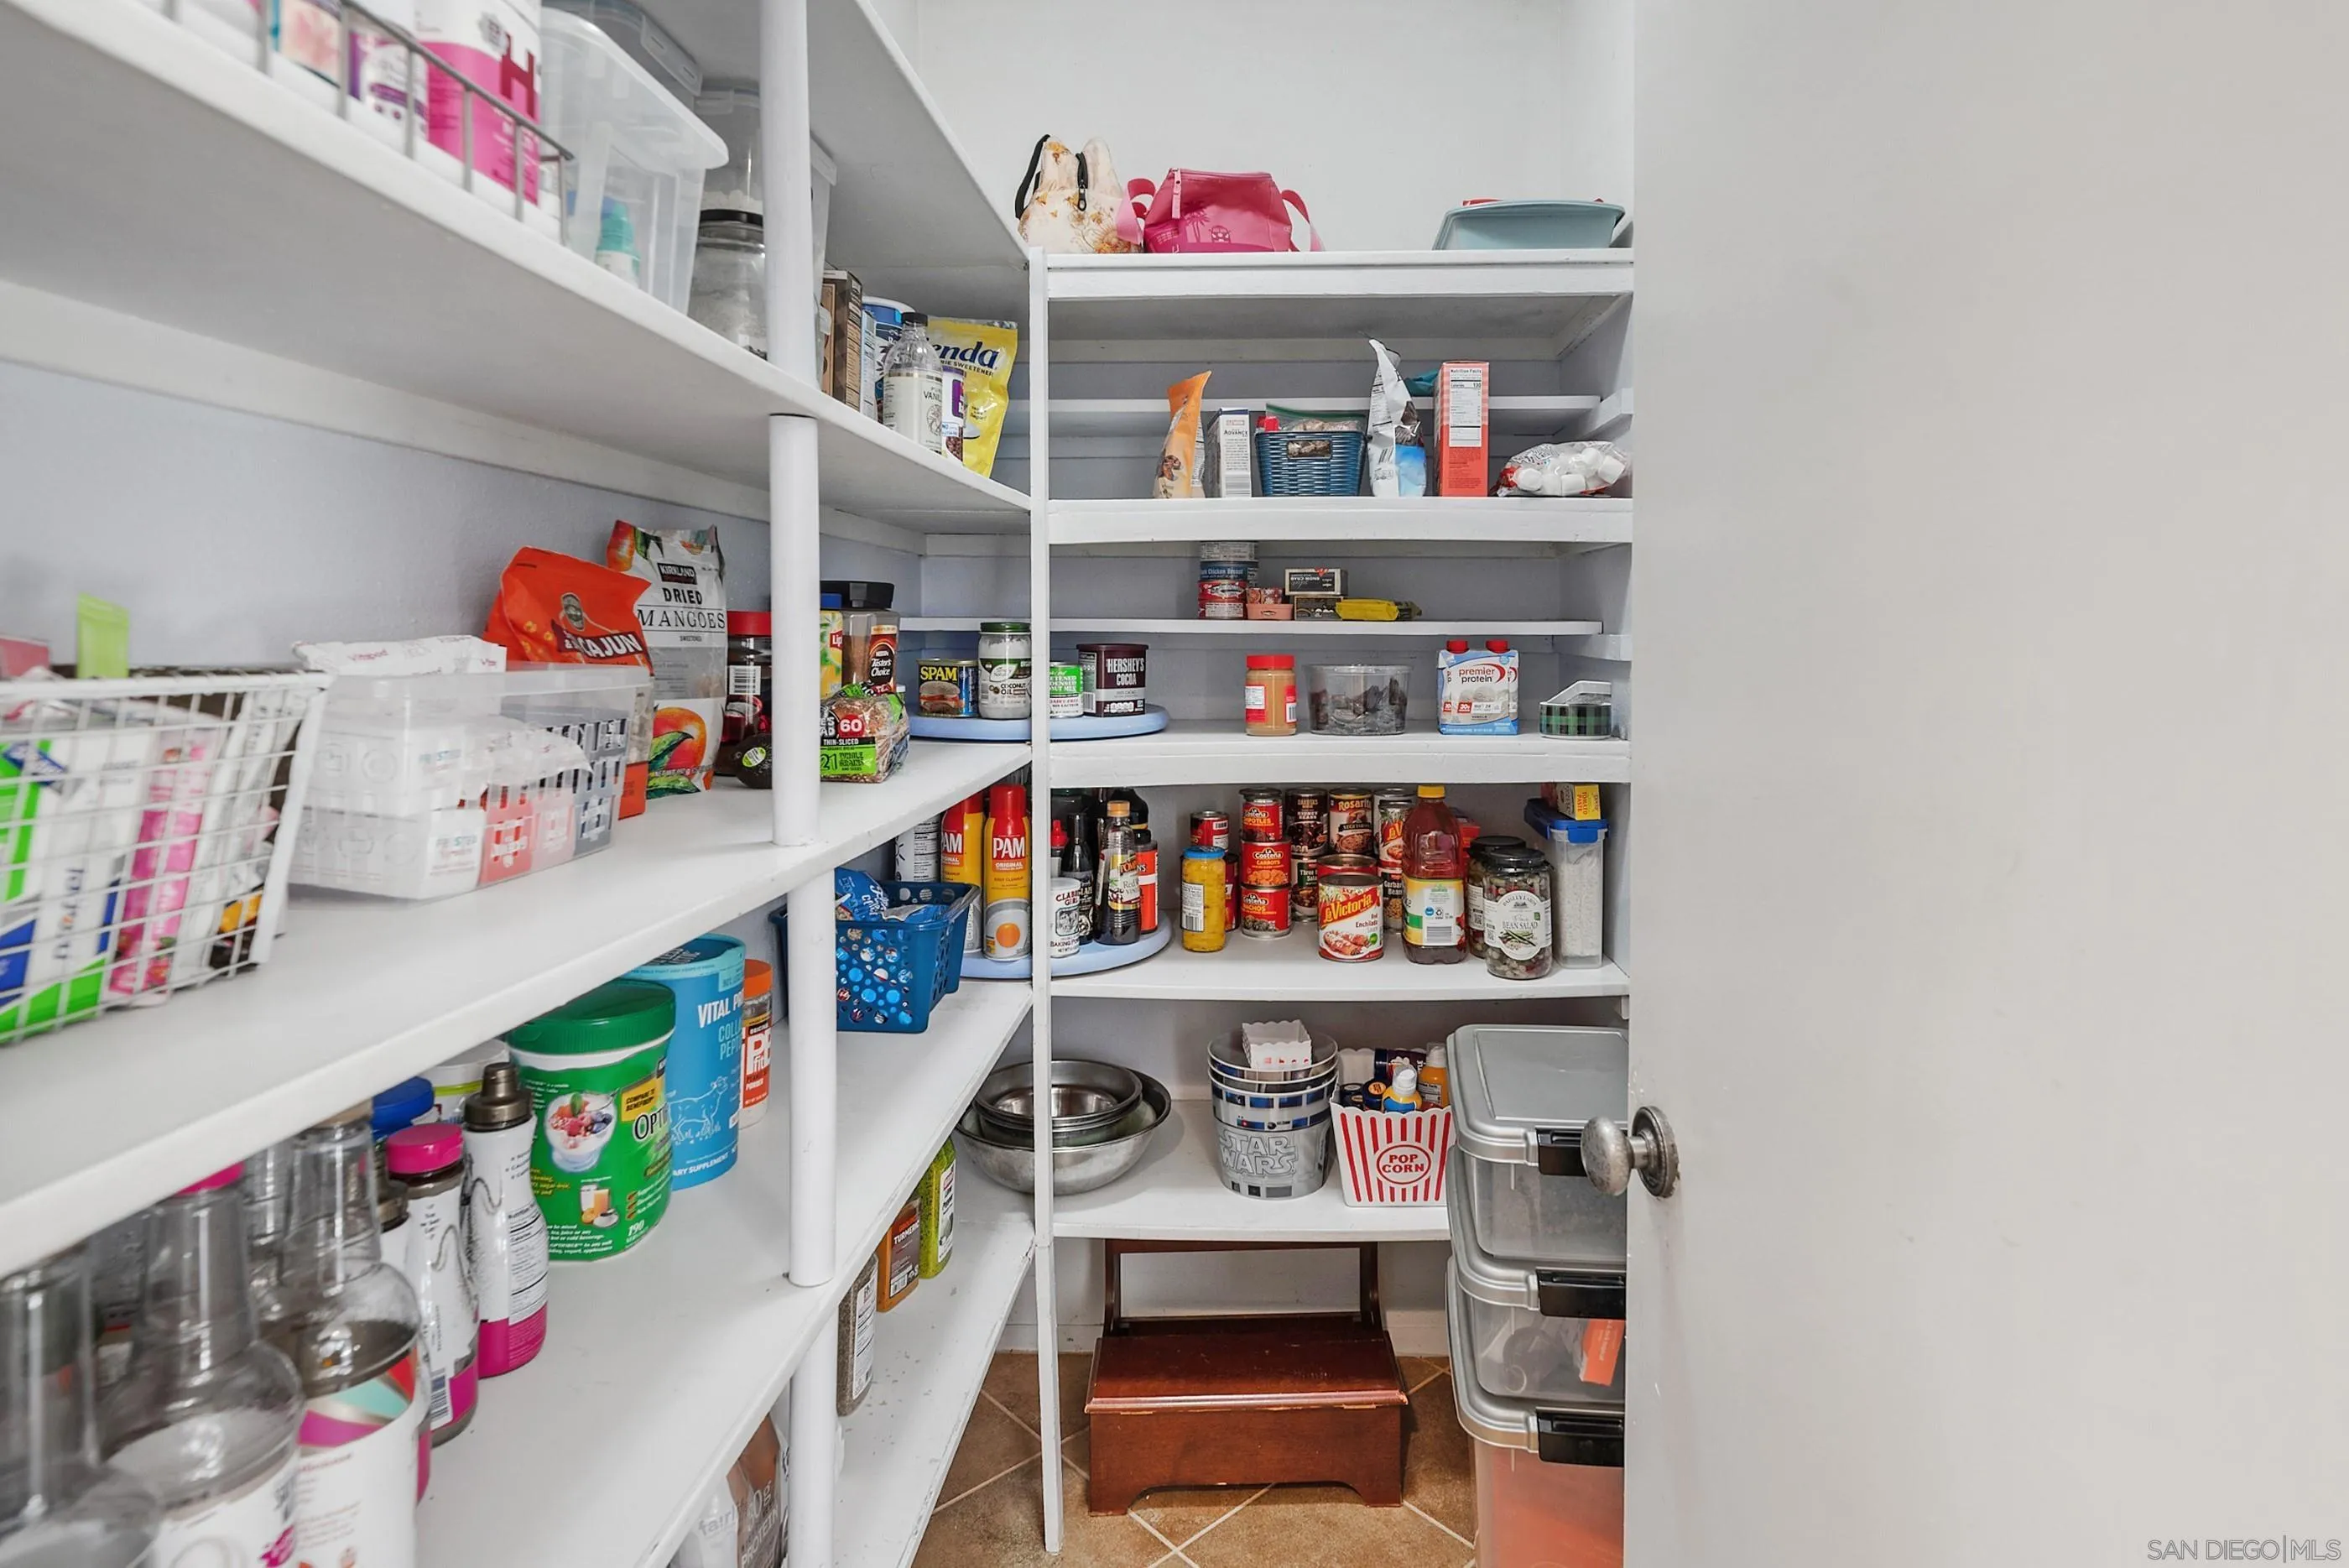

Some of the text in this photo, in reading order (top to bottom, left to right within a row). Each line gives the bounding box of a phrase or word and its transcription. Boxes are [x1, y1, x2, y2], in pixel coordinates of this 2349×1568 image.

[660, 565, 695, 578] KIRKLAND
[663, 587, 703, 605] DRIED
[638, 609, 726, 628] MANGOES
[579, 633, 643, 658] CAJUN
[920, 666, 957, 680] SPAM
[1107, 658, 1144, 673] HERSHEY'S
[1459, 667, 1495, 677] premier
[1117, 674, 1137, 685] COCOA
[1461, 675, 1492, 684] protein
[840, 719, 862, 732] 60
[820, 753, 837, 770] 21
[992, 836, 1025, 859] PAM
[1331, 893, 1372, 920] Victoria
[698, 998, 731, 1029] VITAL
[1220, 1131, 1295, 1156] STAR
[689, 1152, 728, 1174] SUPPLEMENT
[1221, 1151, 1298, 1175] WARS
[1388, 1154, 1419, 1164] POP
[1382, 1164, 1425, 1174] CORN
